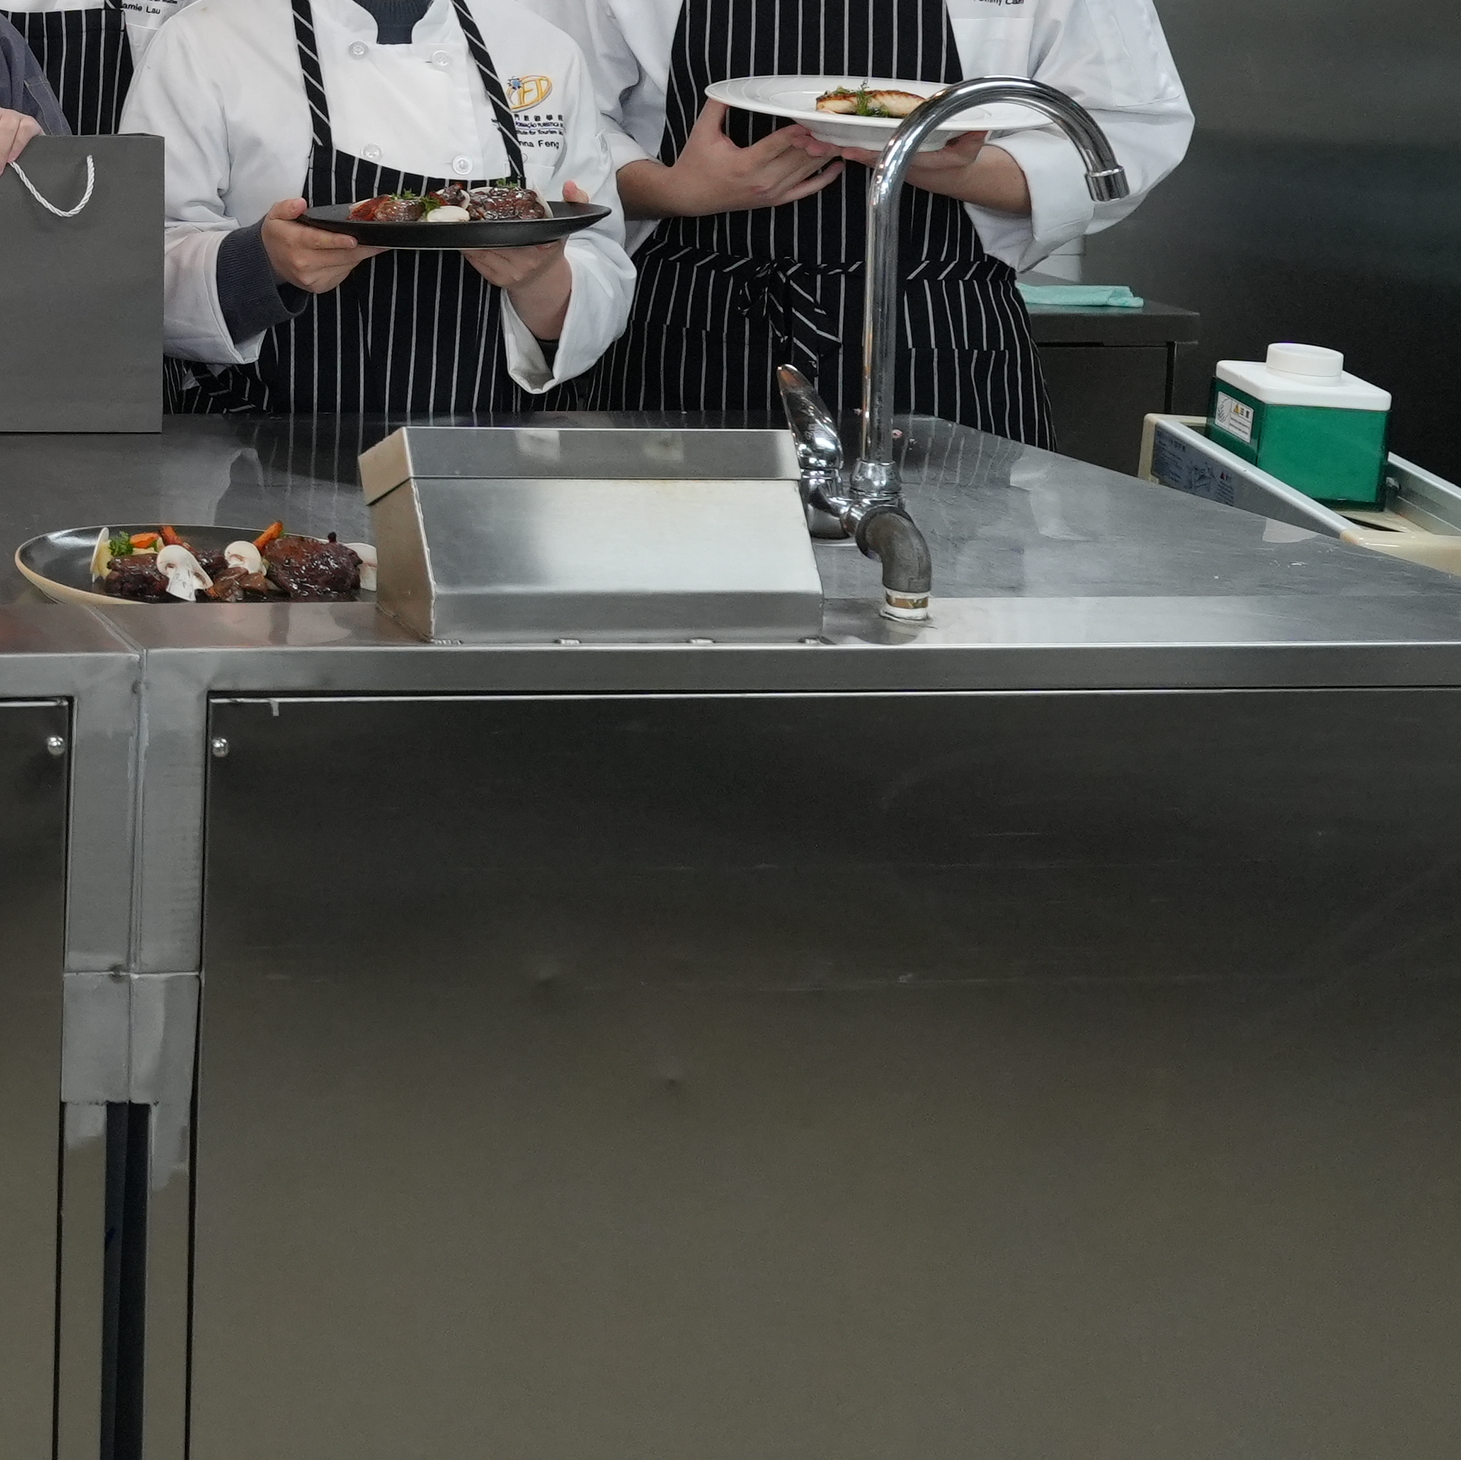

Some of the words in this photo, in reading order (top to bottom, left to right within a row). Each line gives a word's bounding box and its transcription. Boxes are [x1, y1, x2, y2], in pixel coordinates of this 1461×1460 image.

[121, 3, 143, 12] amie
[146, 5, 161, 15] Lau
[518, 140, 535, 148] nna
